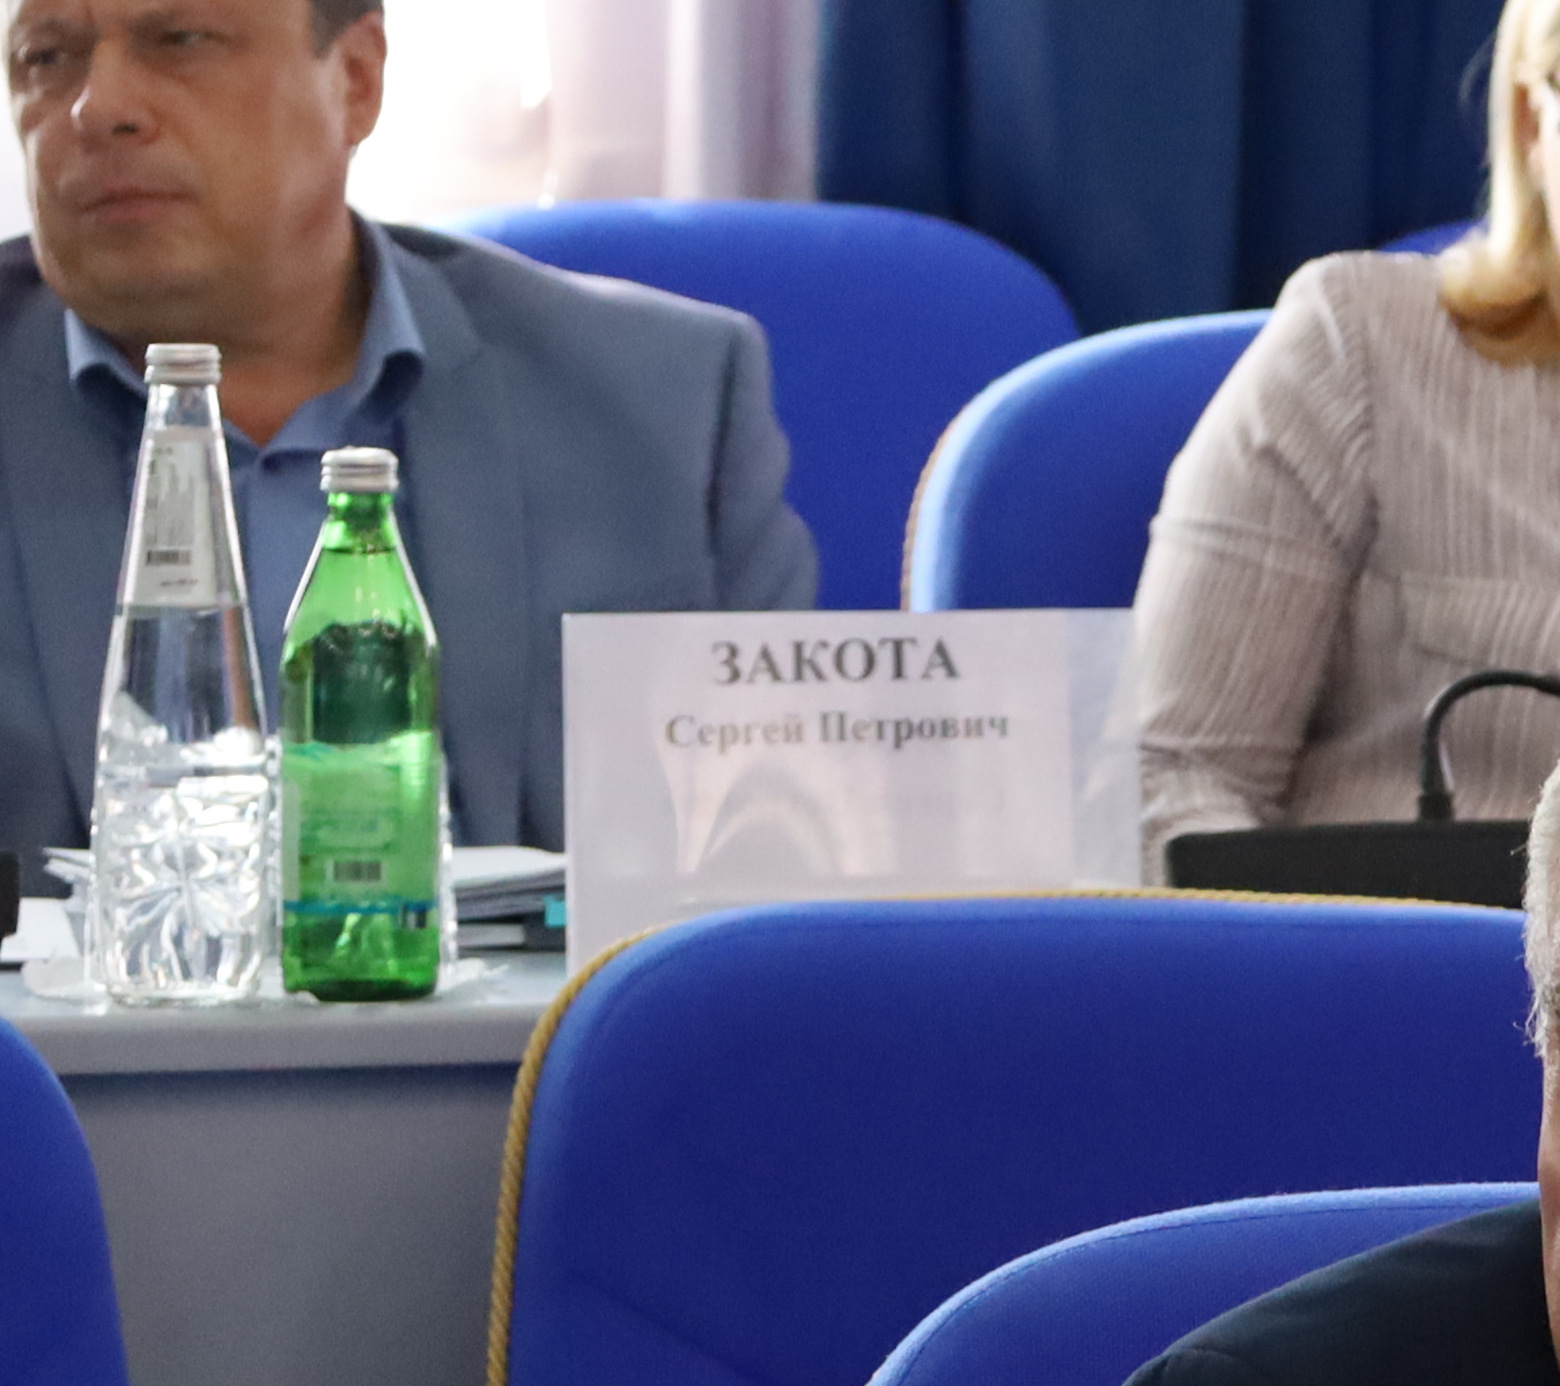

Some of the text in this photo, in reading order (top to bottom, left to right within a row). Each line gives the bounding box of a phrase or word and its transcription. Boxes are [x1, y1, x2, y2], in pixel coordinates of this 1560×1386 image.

[710, 636, 962, 685] ЗАКОТА
[664, 710, 1009, 755] Сергей Петрович
